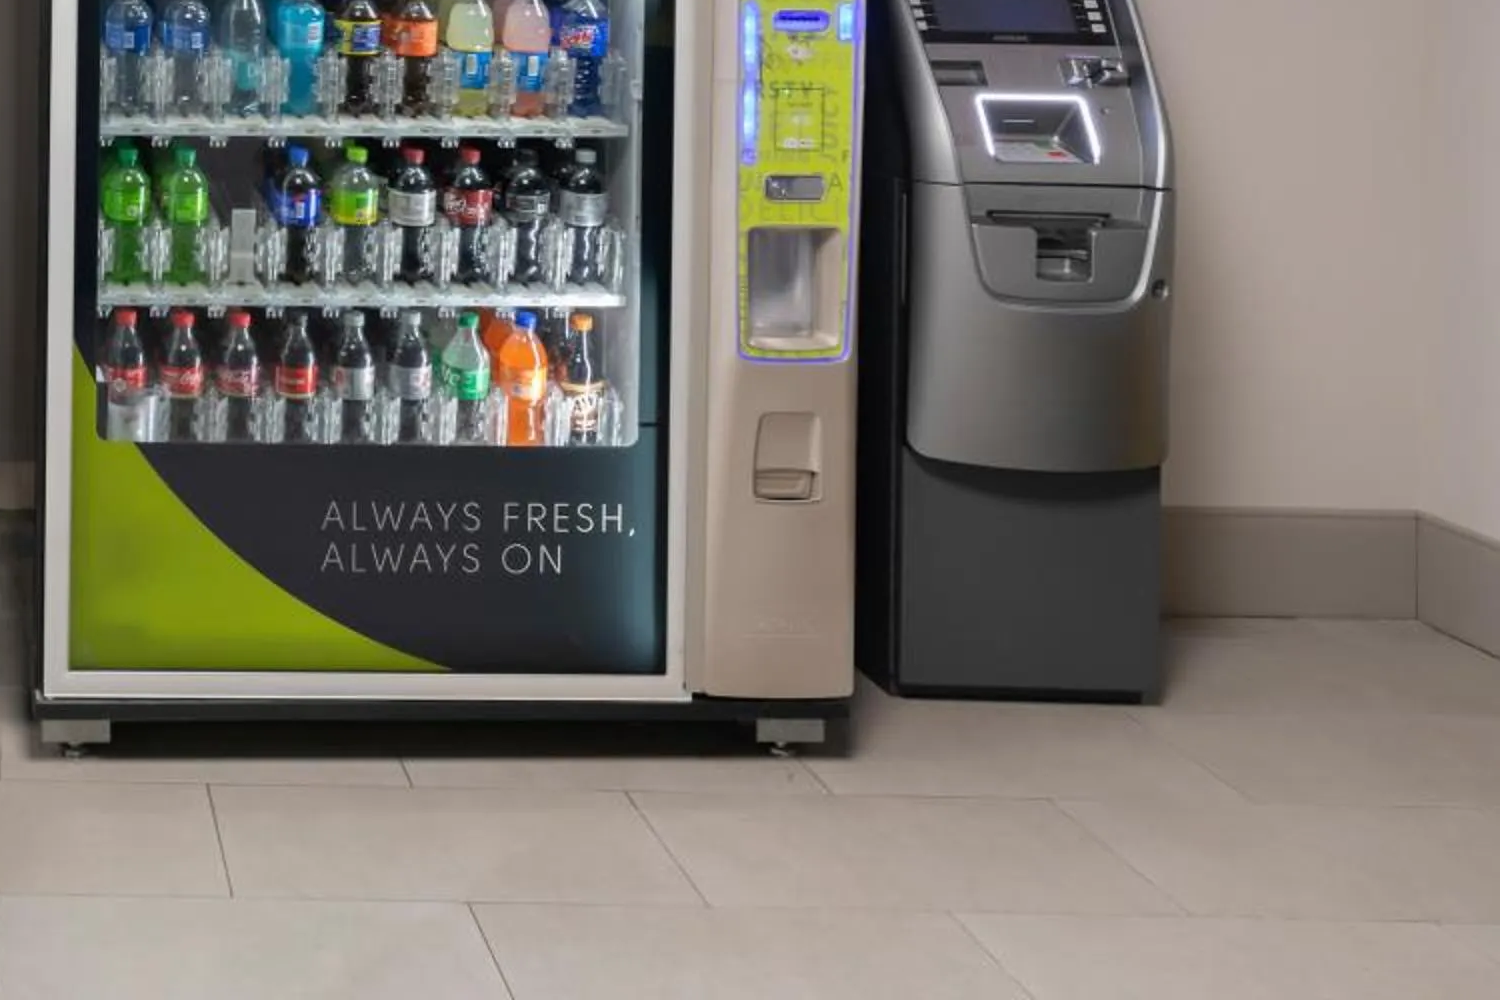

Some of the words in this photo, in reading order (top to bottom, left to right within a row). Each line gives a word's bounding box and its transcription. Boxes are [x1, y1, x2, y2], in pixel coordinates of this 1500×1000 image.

[321, 500, 481, 533] ALWAYS
[503, 501, 635, 537] FRESH,
[320, 542, 480, 574] ALWAYS
[501, 543, 562, 575] ON
